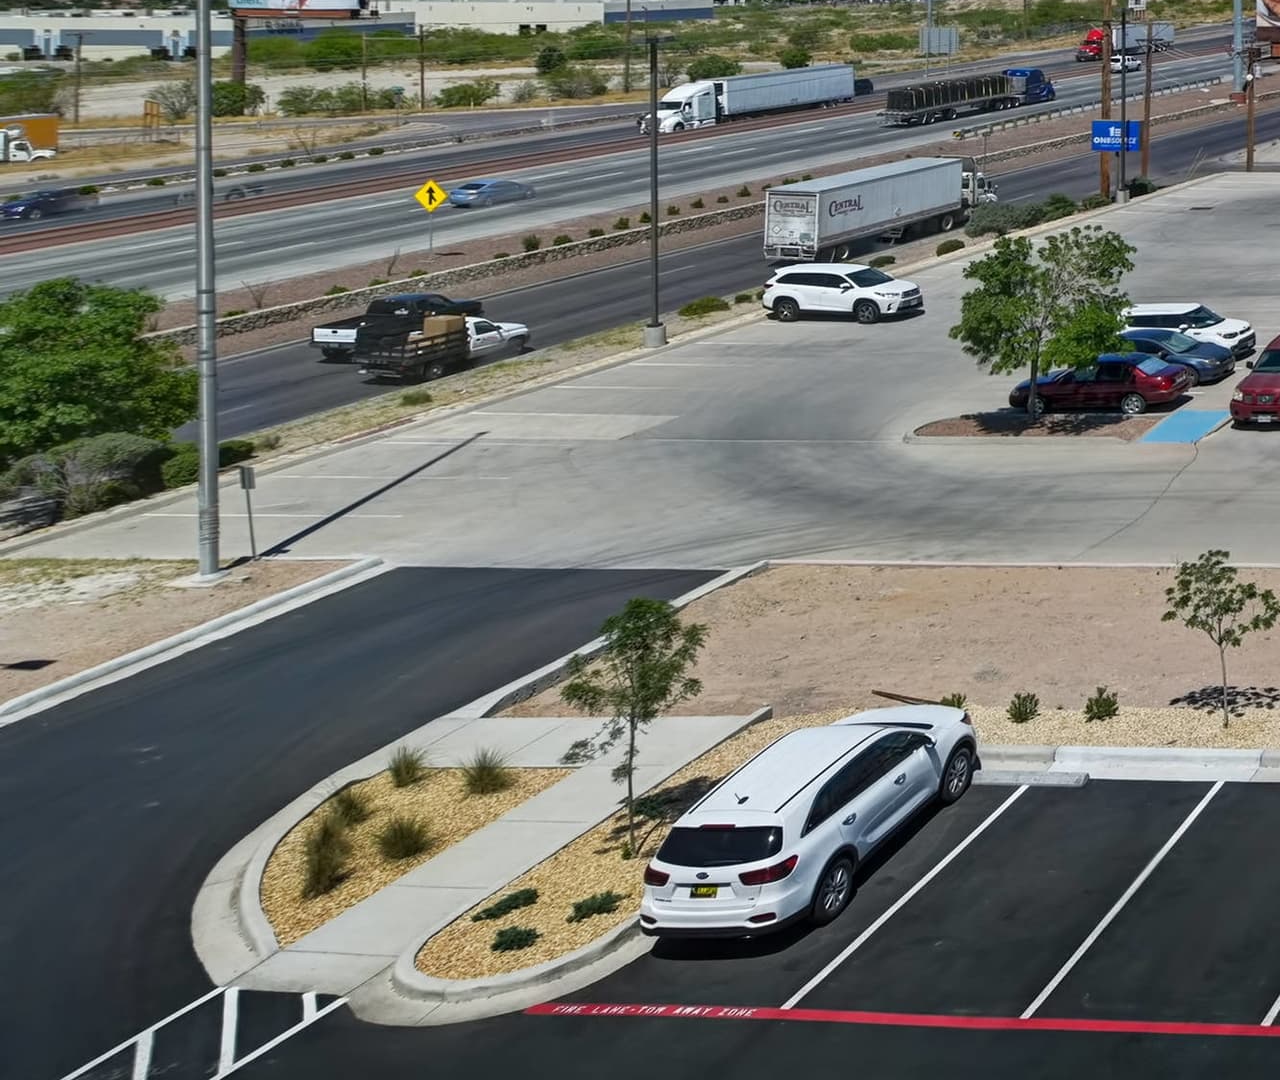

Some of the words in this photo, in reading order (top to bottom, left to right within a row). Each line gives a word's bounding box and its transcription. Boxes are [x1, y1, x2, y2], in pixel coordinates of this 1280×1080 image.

[773, 200, 813, 214] CENTRAL
[828, 194, 864, 217] CENTRAL
[552, 1005, 585, 1013] FIRE
[673, 1006, 713, 1016] AWAY
[717, 1008, 757, 1017] ZONE
